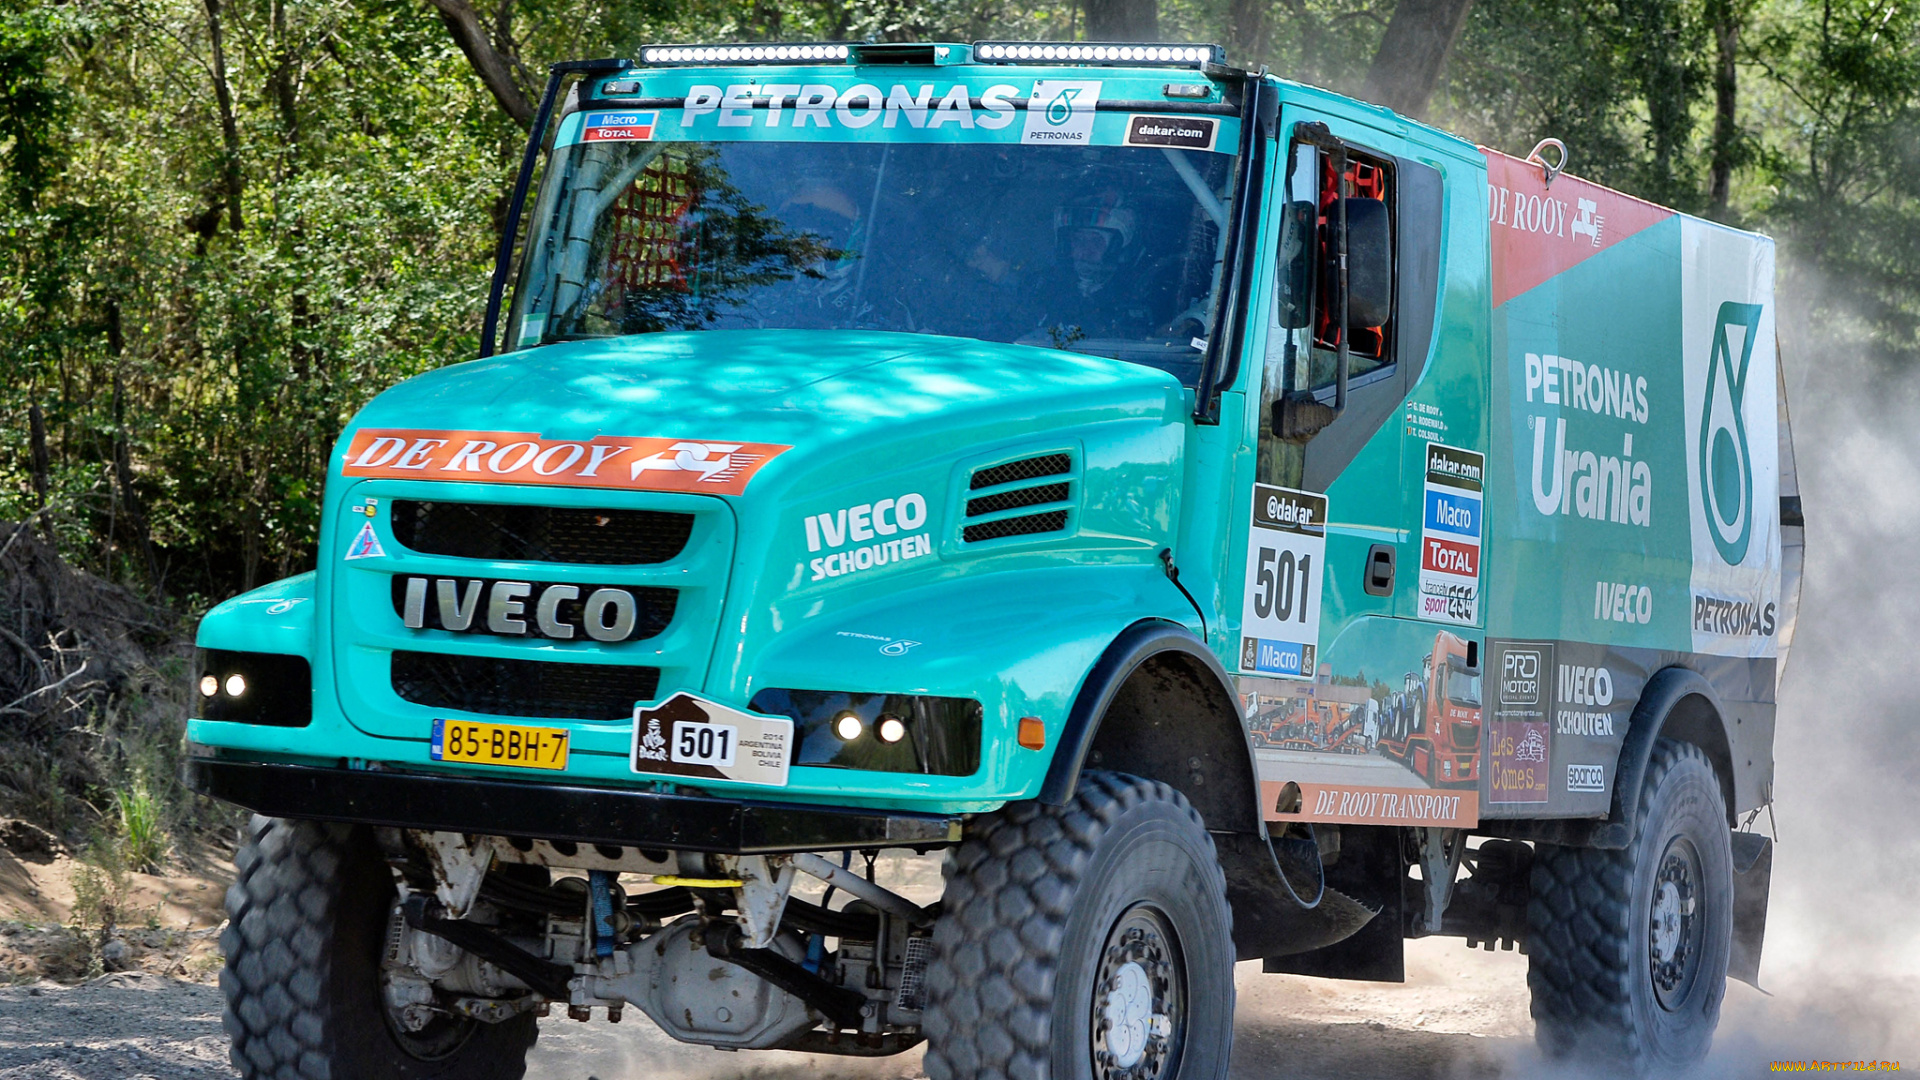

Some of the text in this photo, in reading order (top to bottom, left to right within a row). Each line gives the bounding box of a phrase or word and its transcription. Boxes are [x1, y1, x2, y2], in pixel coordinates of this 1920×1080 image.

[602, 114, 638, 125] Macro
[680, 84, 1020, 129] PETRONAS
[598, 128, 634, 138] TOTAL
[1030, 131, 1083, 140] PETRONAS
[1138, 125, 1203, 139] dakar.com
[1488, 183, 1568, 238] DE ROOY
[1524, 353, 1649, 424] PETRONAS
[350, 437, 632, 477] DE ROOY
[1430, 452, 1480, 482] dakar.com
[804, 493, 927, 552] IVECO
[1267, 496, 1313, 525] @dakar
[1436, 498, 1471, 529] Macro
[810, 533, 931, 581] SCHOUTEN
[1430, 542, 1473, 573] TOTAL
[1254, 547, 1311, 624] 501
[404, 577, 637, 642] IVECO
[1425, 597, 1447, 615] sport
[1594, 581, 1652, 625] IVECO
[1695, 595, 1776, 637] PETRONAS
[836, 631, 891, 642] PETRONAS
[1261, 645, 1297, 669] Macro
[1504, 654, 1537, 678] PRO
[1503, 680, 1536, 693] MOTOR
[1558, 664, 1613, 706] IVECO
[763, 733, 784, 741] 2014
[1557, 709, 1613, 736] SCHOUTEN
[449, 726, 567, 762] 85-BBH-7
[679, 727, 729, 760] 501
[738, 740, 782, 750] ARGENTINA
[752, 750, 782, 759] BOLIVIA
[1491, 731, 1513, 756] Les
[758, 760, 781, 768] CHILE
[1569, 767, 1603, 787] sparco
[1314, 790, 1461, 820] DE ROOY TRANSPORT
